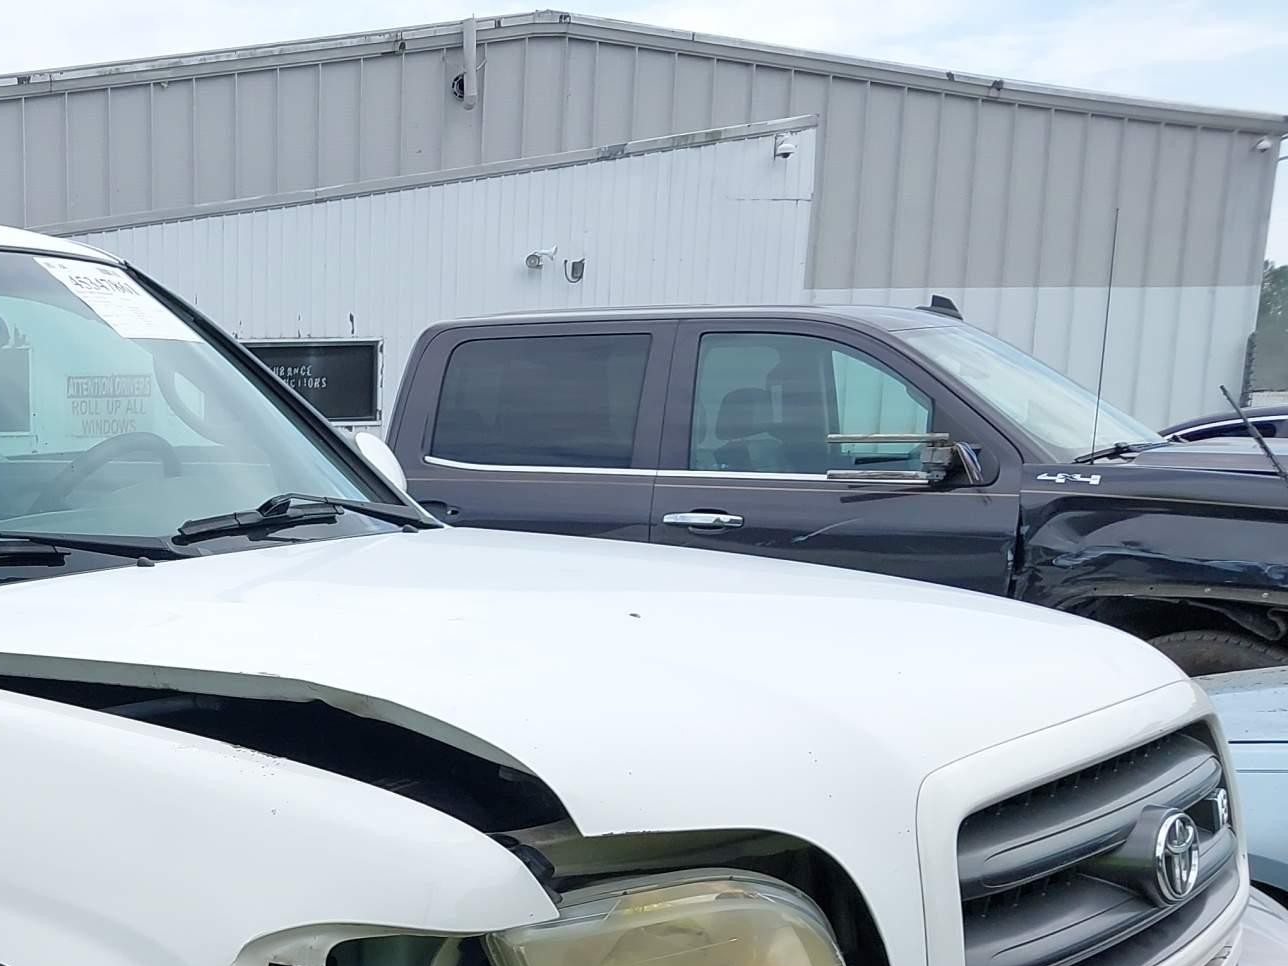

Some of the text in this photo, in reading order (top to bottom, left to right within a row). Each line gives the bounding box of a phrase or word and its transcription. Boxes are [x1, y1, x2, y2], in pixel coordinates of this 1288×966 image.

[272, 364, 313, 377] URANCE
[67, 375, 151, 397] ATTENTION DRIVERS
[72, 399, 146, 415] ROLL UP ALL
[82, 418, 137, 435] WINDOWS
